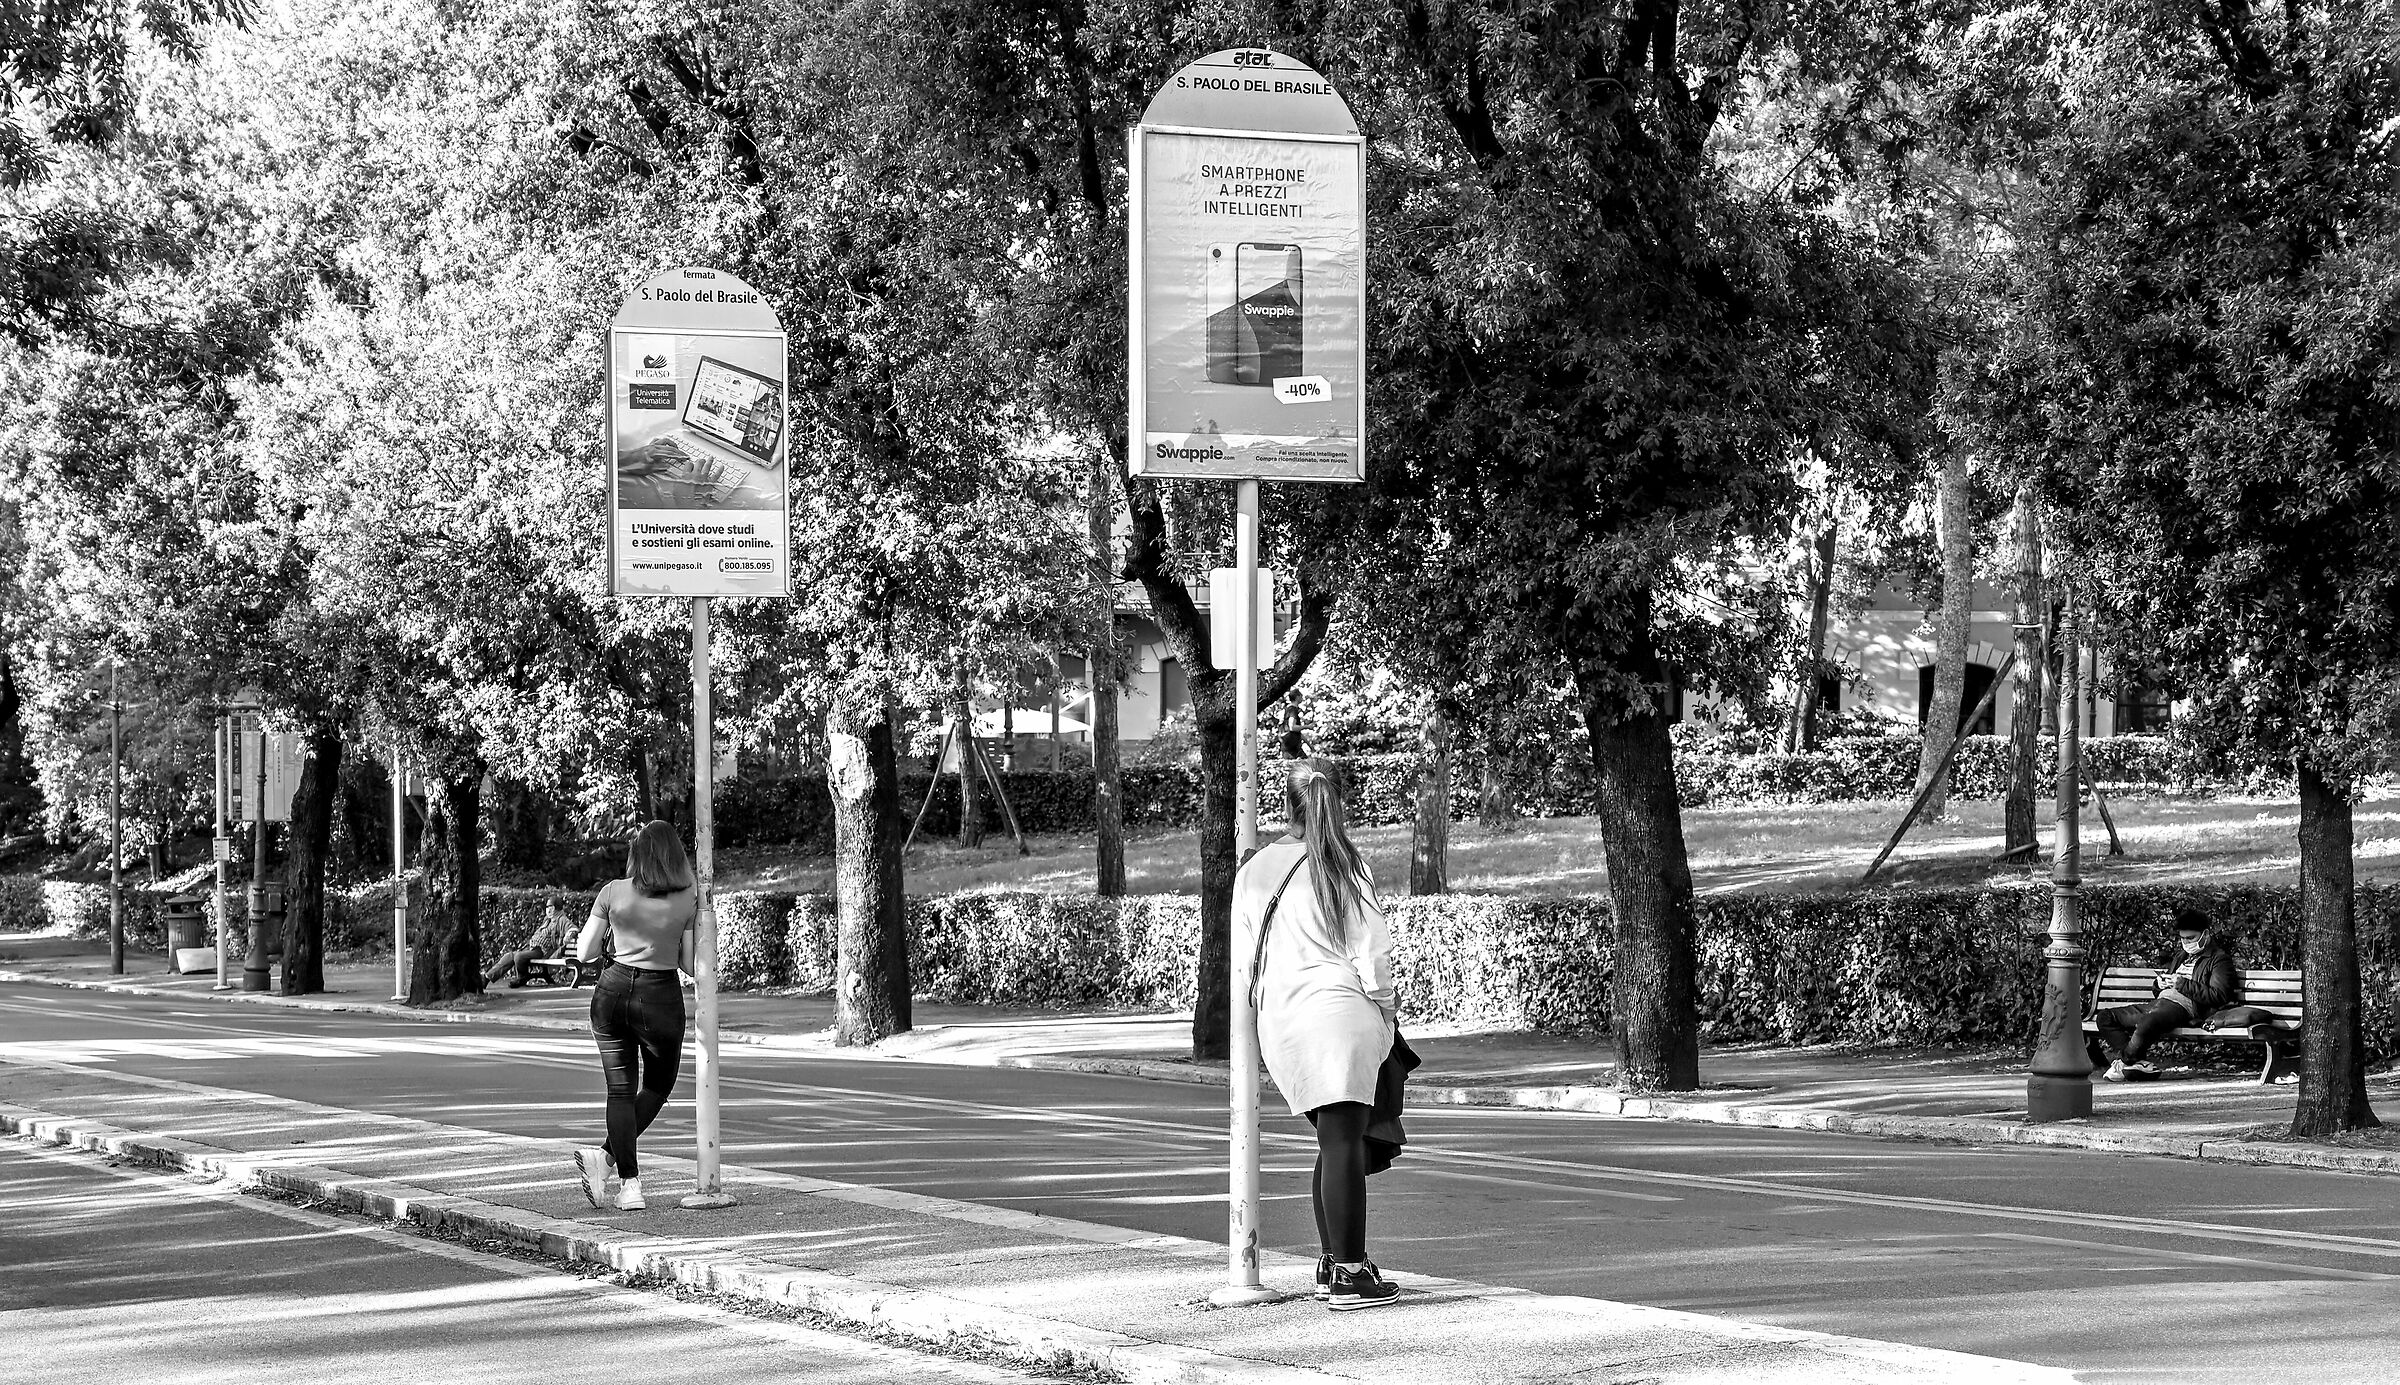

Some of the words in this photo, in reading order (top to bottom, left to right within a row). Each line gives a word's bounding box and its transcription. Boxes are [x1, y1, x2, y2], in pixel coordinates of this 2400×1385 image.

[1233, 50, 1274, 70] atac
[1177, 77, 1190, 89] S.
[1194, 77, 1240, 91] PAOLO
[1244, 80, 1271, 93] DEL
[1274, 82, 1332, 95] BRASILE
[1201, 164, 1305, 182] SMARTPHONE
[1219, 183, 1229, 196] A
[1235, 184, 1287, 199] PREZZI
[1204, 200, 1302, 218] INTELLIGENTI
[683, 270, 716, 279] fermata
[641, 288, 652, 301] S.
[656, 288, 691, 302] Paolo
[694, 290, 714, 303] del
[717, 291, 758, 304] Brasile
[1244, 303, 1295, 319] Swappie
[635, 369, 670, 378] PEGASO
[636, 389, 669, 397] Università
[1284, 383, 1321, 397] -40%
[635, 396, 671, 405] Telematica
[632, 523, 695, 535] L'Università
[698, 524, 725, 535] dove
[727, 524, 755, 535] studi
[632, 539, 639, 548] e
[641, 538, 684, 548] sostieni
[686, 537, 700, 550] gli
[702, 538, 735, 548] esami
[737, 538, 774, 549] online.
[632, 561, 703, 572] www.unipegaso.it
[724, 562, 771, 570] 800.185.095
